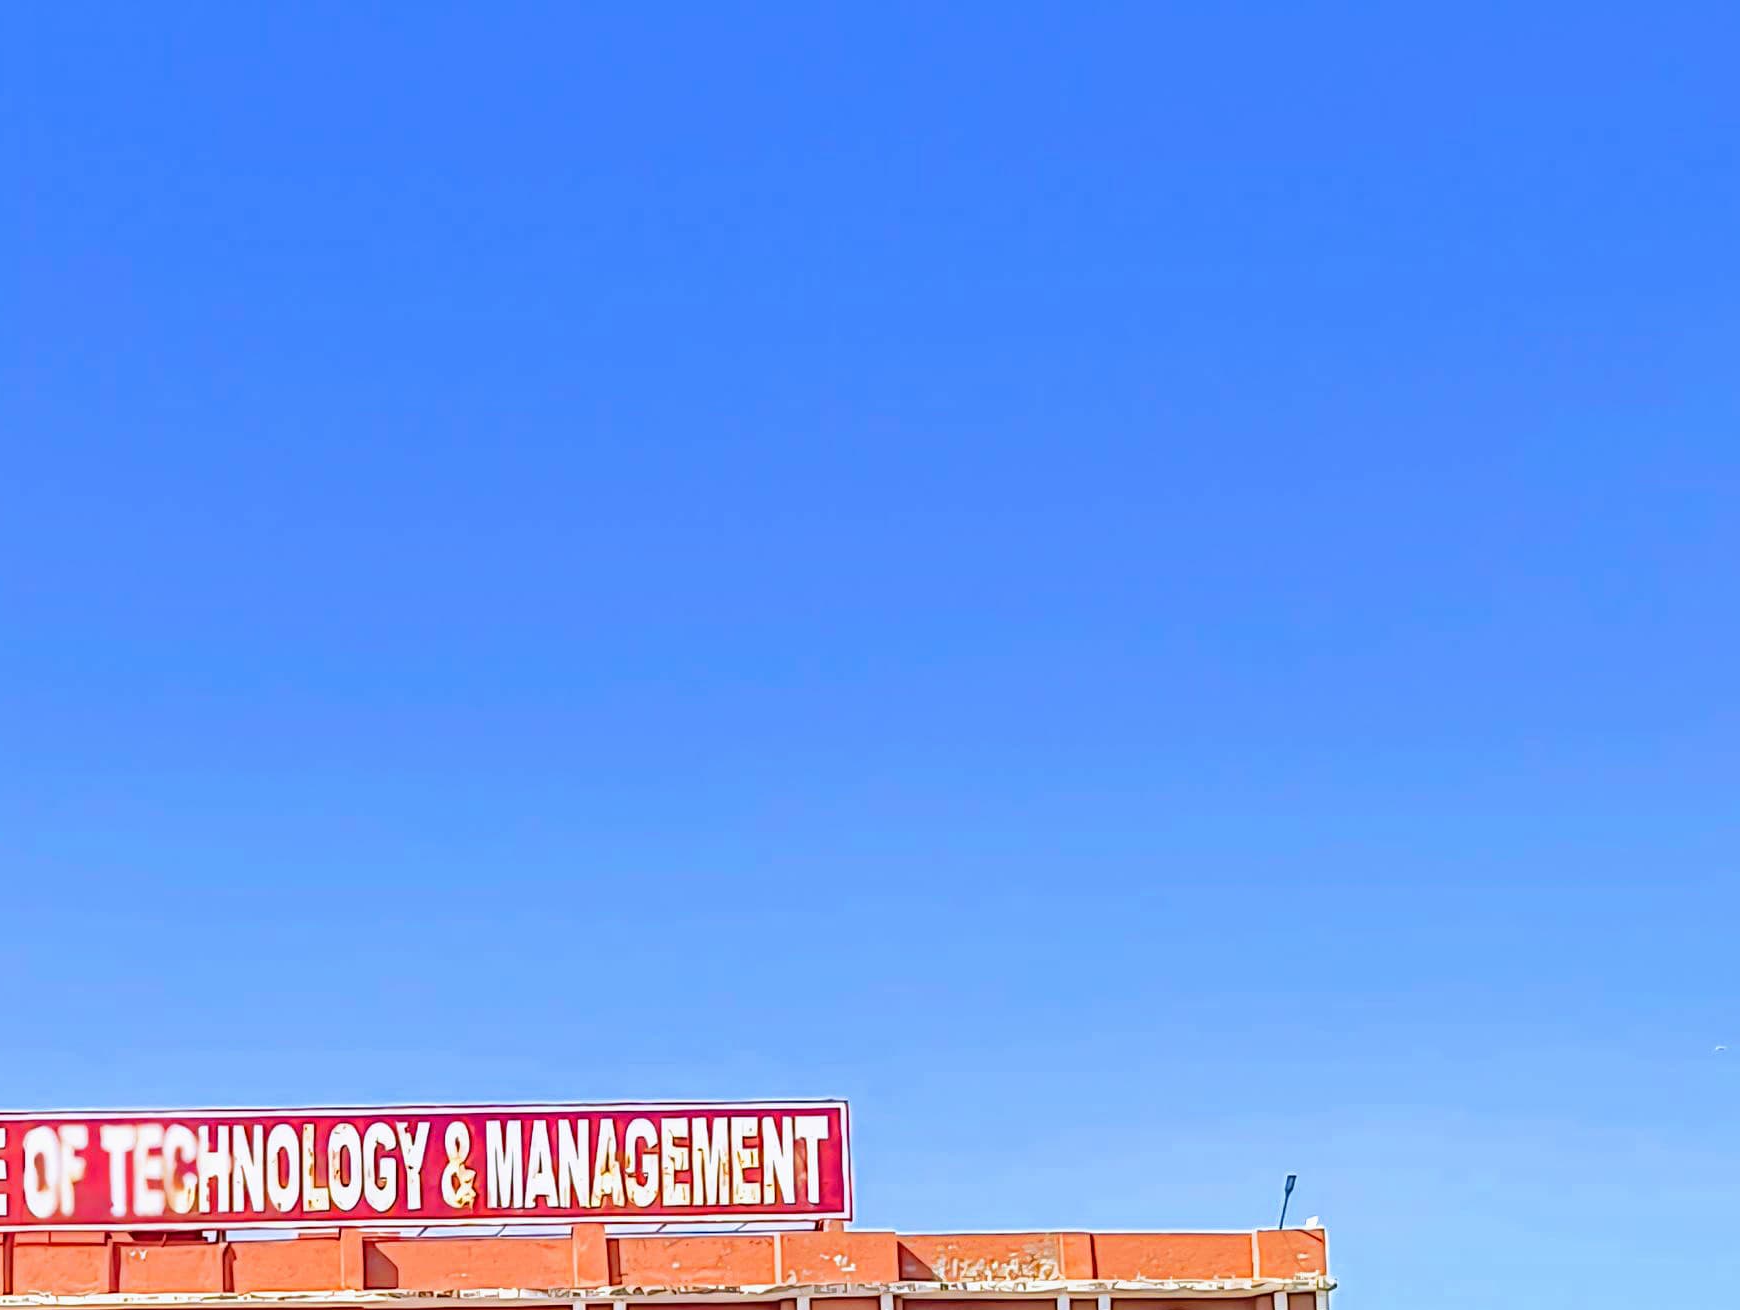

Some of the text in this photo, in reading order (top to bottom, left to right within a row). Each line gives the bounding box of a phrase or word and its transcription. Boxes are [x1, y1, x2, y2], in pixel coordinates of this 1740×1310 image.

[22, 1123, 90, 1221] OF
[100, 1119, 432, 1218] TECHNOLOGY
[441, 1118, 478, 1210] &
[486, 1114, 830, 1210] MANAGEMENT
